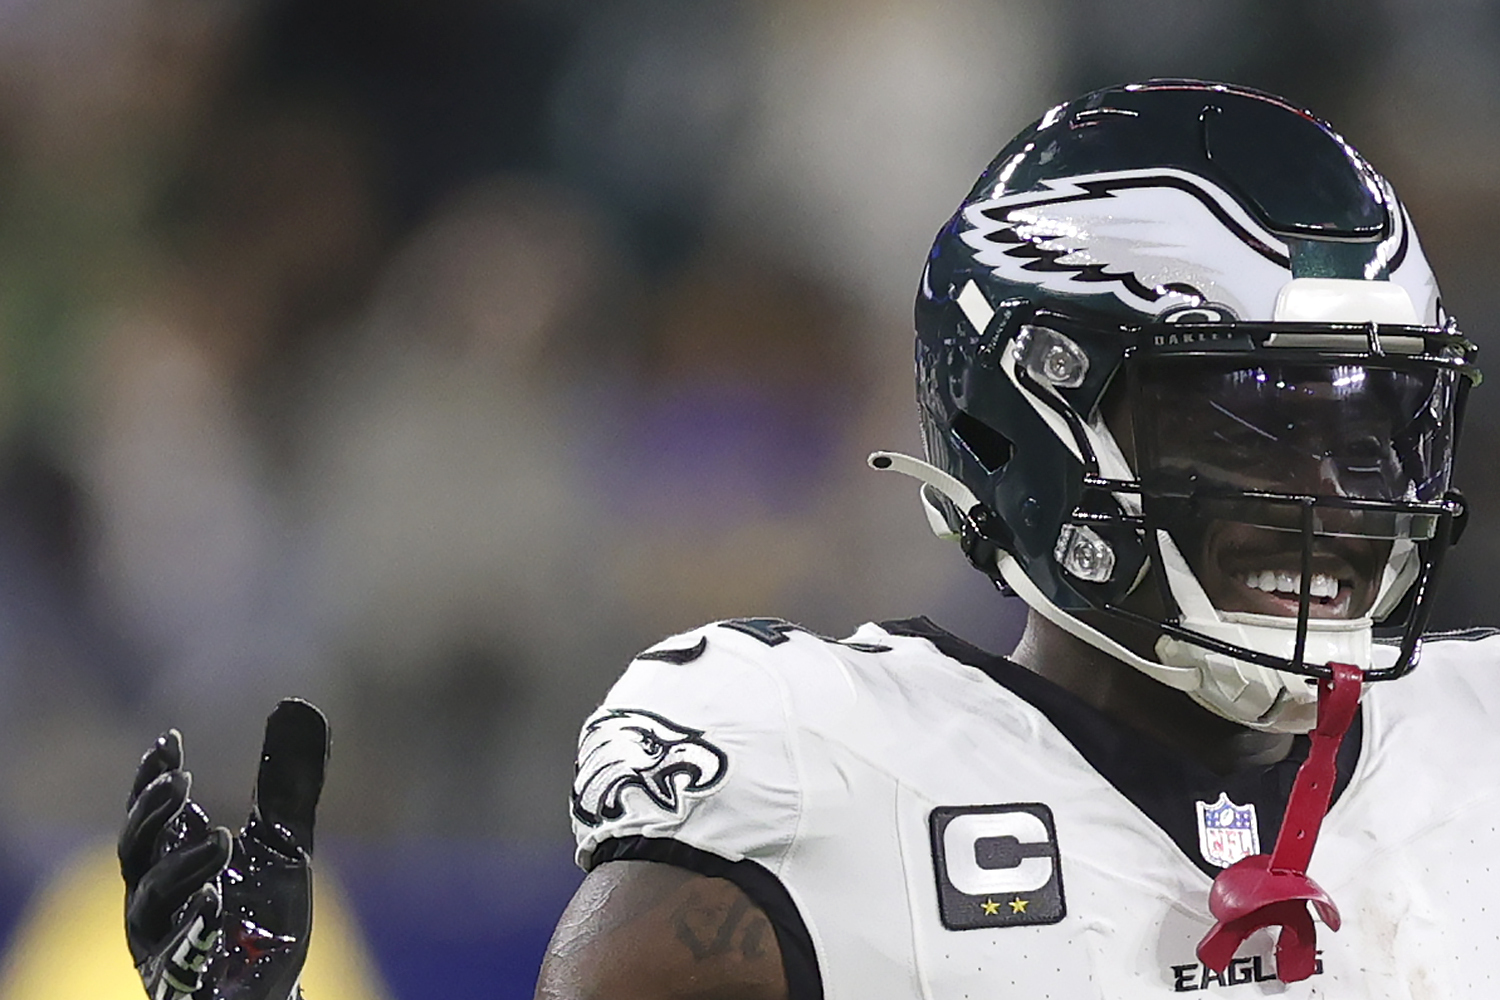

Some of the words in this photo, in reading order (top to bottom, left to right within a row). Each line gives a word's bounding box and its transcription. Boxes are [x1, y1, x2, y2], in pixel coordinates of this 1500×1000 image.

[944, 811, 1053, 895] C
[1210, 831, 1250, 858] NFL
[1171, 951, 1324, 992] EAGL
